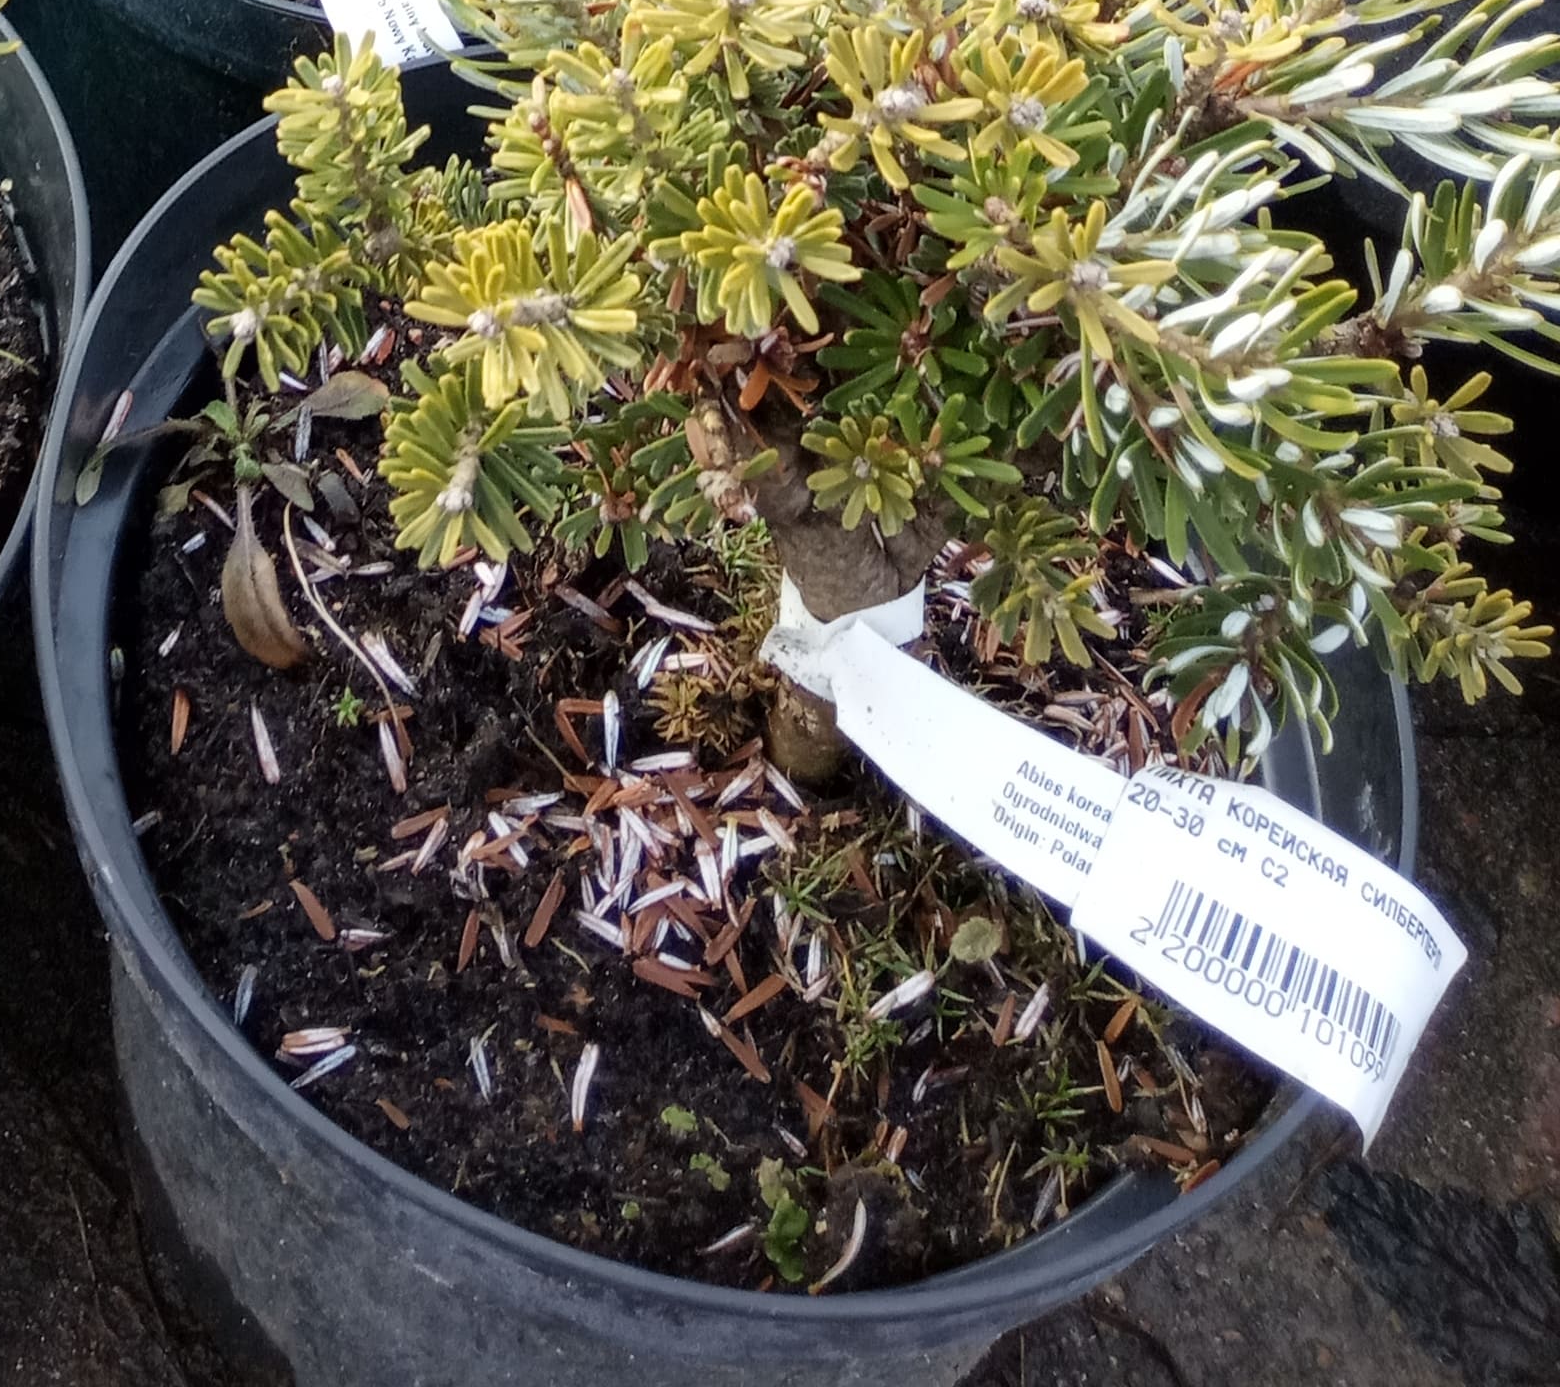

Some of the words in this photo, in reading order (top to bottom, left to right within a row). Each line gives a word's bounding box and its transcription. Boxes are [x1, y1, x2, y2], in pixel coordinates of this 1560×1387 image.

[1016, 760, 1064, 798] Abies
[1127, 782, 1206, 837] 20-30
[993, 804, 1047, 847] Origin:
[1002, 781, 1104, 851] Ogrodnictwa
[1146, 765, 1217, 806] ПИХТА
[1226, 797, 1349, 888] КОРЕЙСКАЯ
[1128, 915, 1154, 946] 2
[1161, 933, 1286, 1018] 200000
[1300, 1008, 1385, 1084] 101099
